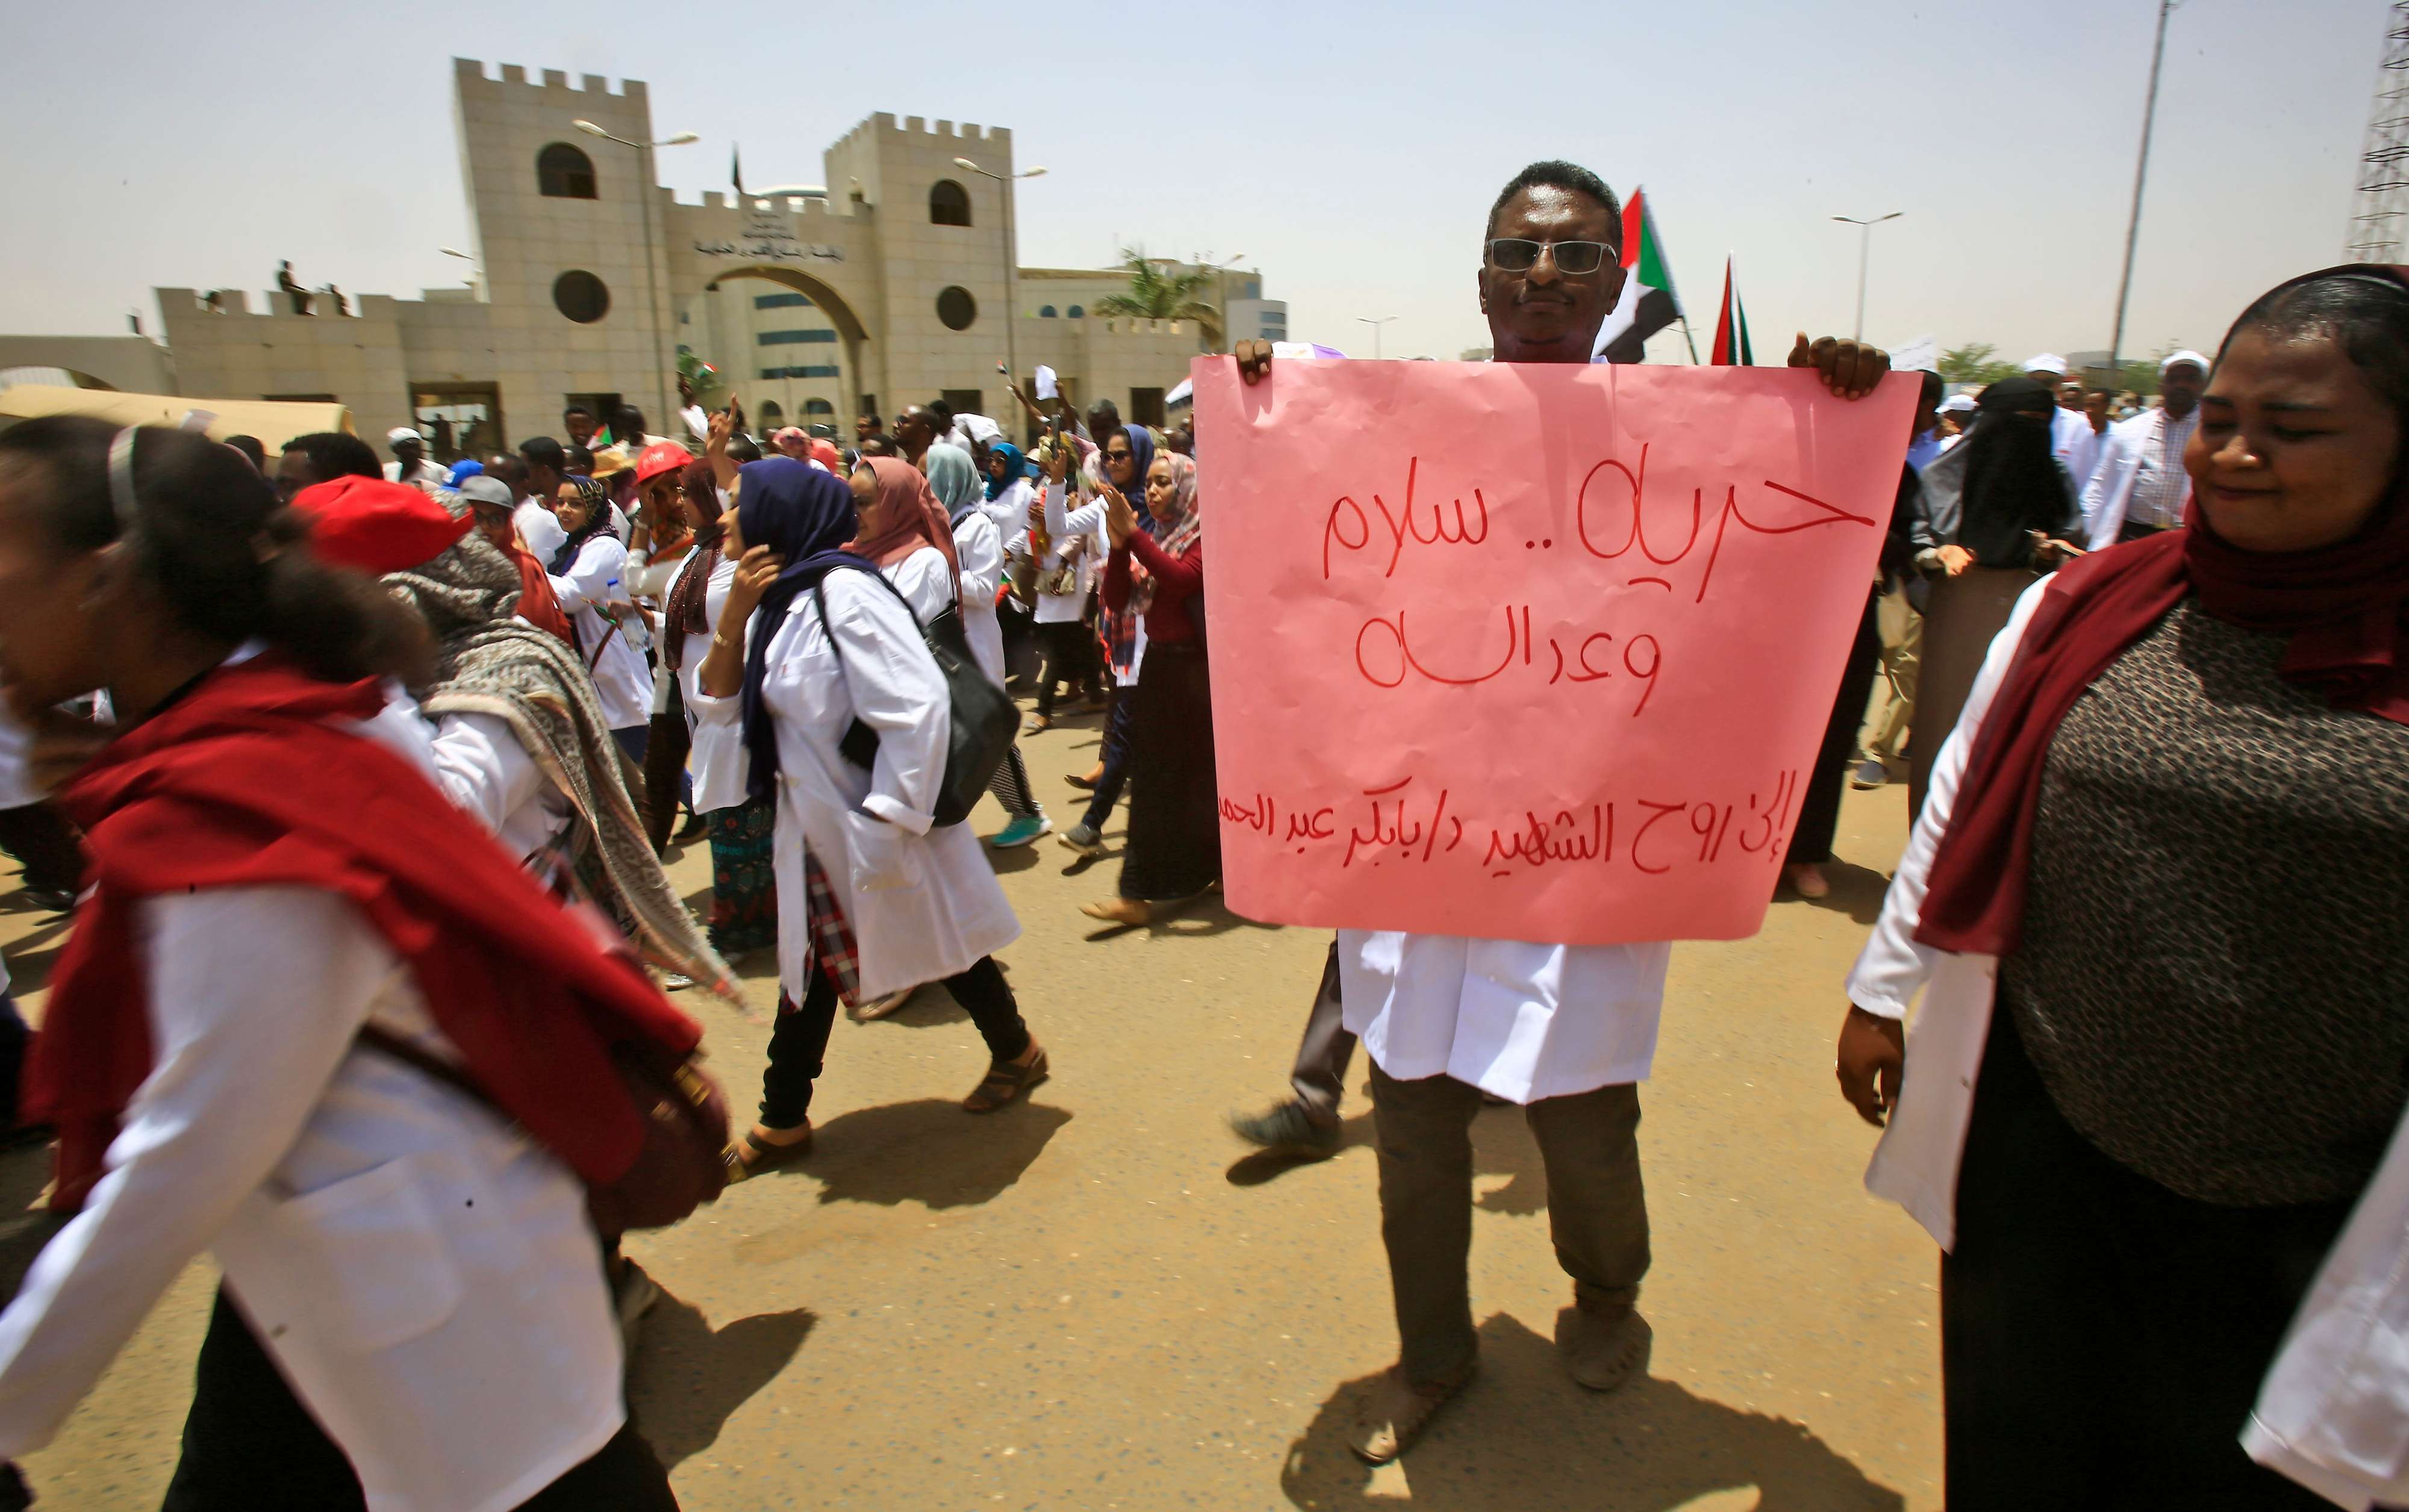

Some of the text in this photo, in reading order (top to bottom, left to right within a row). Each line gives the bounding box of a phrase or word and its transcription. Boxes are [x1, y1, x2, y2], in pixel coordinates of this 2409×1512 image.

[1323, 455, 1489, 581] سلام
[1285, 807, 1336, 856] عبد
[1482, 801, 1615, 879] الشهيد
[1631, 798, 1734, 876] روح
[1738, 770, 1798, 863] إلى
